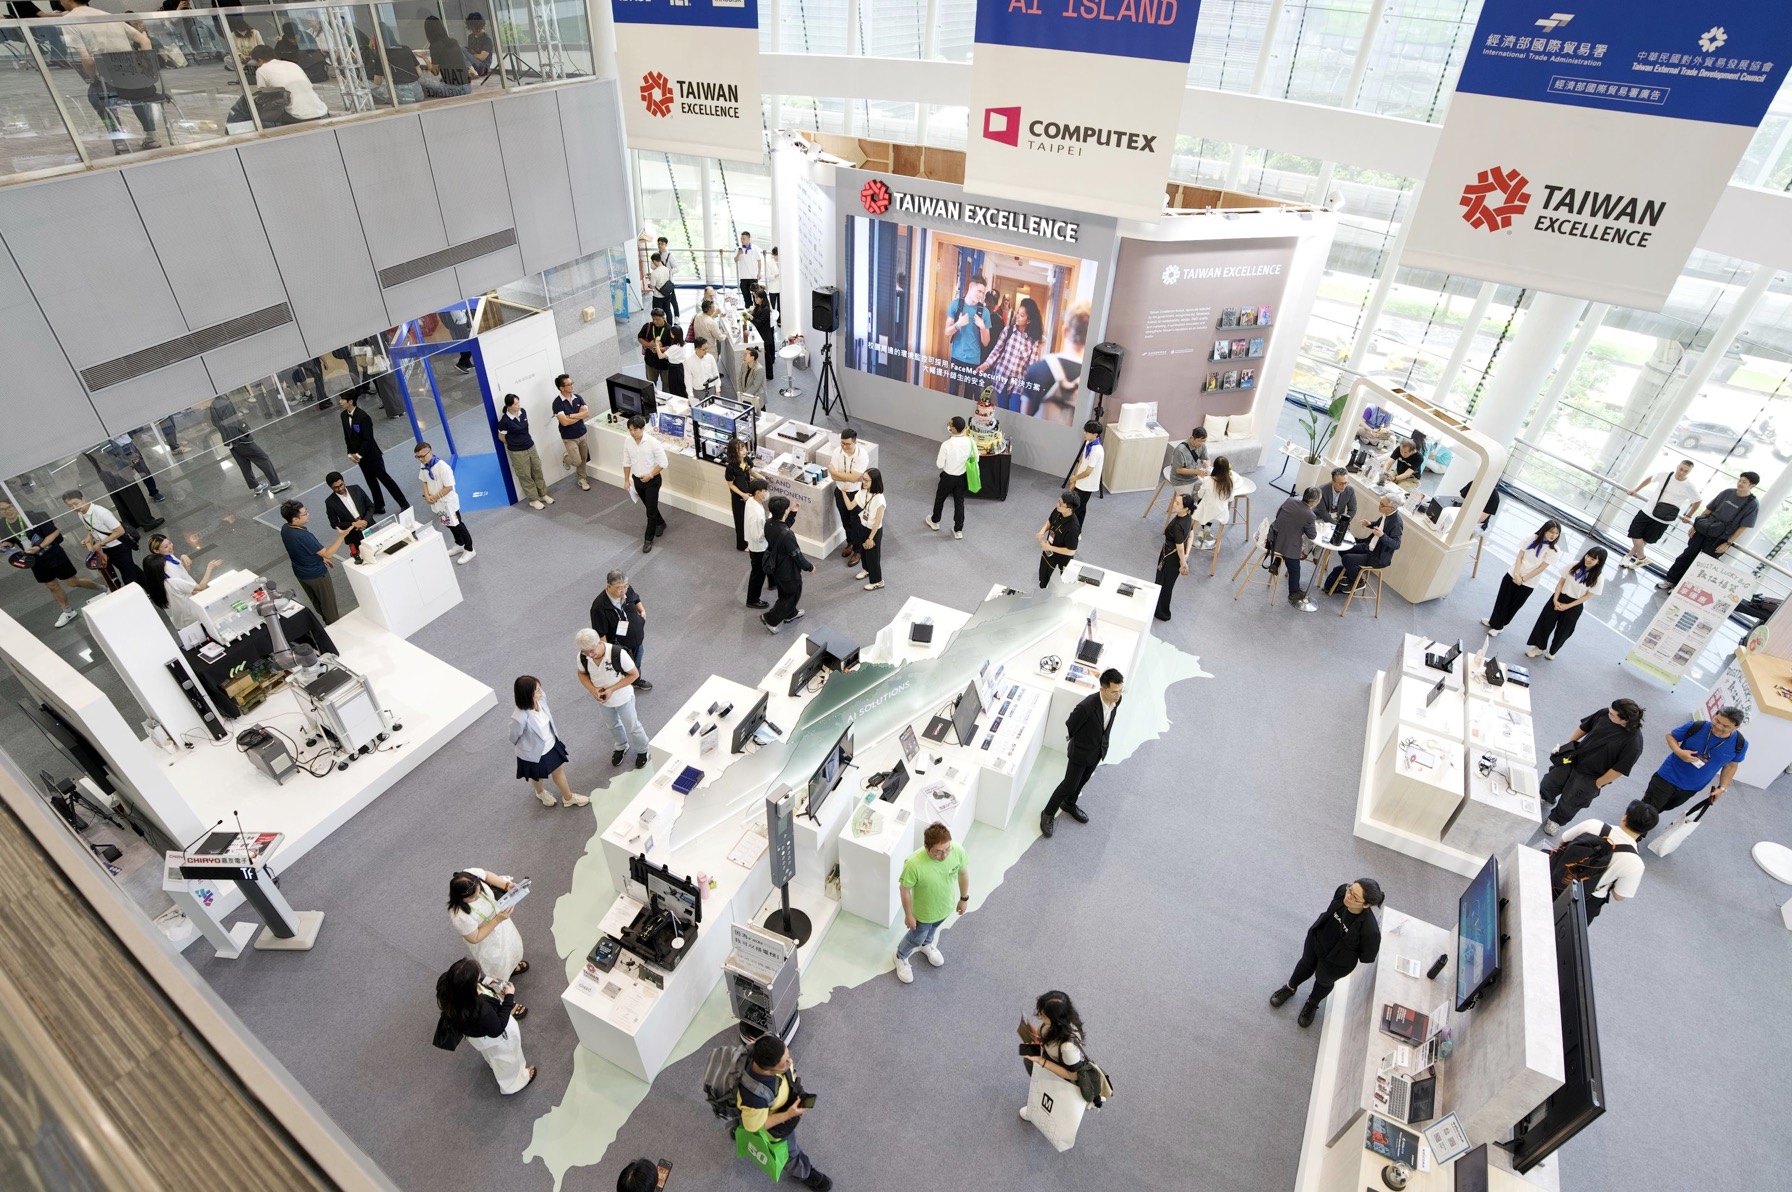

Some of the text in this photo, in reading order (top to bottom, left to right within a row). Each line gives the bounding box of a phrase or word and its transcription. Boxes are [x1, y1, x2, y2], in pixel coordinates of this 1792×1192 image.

[1062, 0, 1178, 26] ISLAND
[1485, 33, 1608, 58] 經濟部國際貿易署
[1482, 48, 1602, 67] International Trade Administration
[1637, 51, 1774, 73] 中華民國對外貿易發展協會
[1631, 62, 1767, 83] Taiwan External Trade Development Council
[676, 80, 739, 103] TAIWAN
[1553, 79, 1661, 101] 經濟部國際貿易署廣告
[681, 102, 740, 118] EXCELLENCE
[1028, 119, 1157, 153] COMPUTEX
[1028, 140, 1082, 156] TAIPEI
[1541, 184, 1667, 227] TAIWAN
[894, 192, 1080, 243] TAIWAN EXCELLENCE
[1533, 215, 1652, 248] EXCELLENCE
[1183, 264, 1282, 280] TAIWAN EXCELLENCE
[950, 361, 977, 374] FaceMe
[978, 369, 1009, 385] Security
[768, 485, 812, 504] OMPONENTS
[775, 479, 790, 489] AND
[847, 680, 911, 723] AI SOLUTIONS
